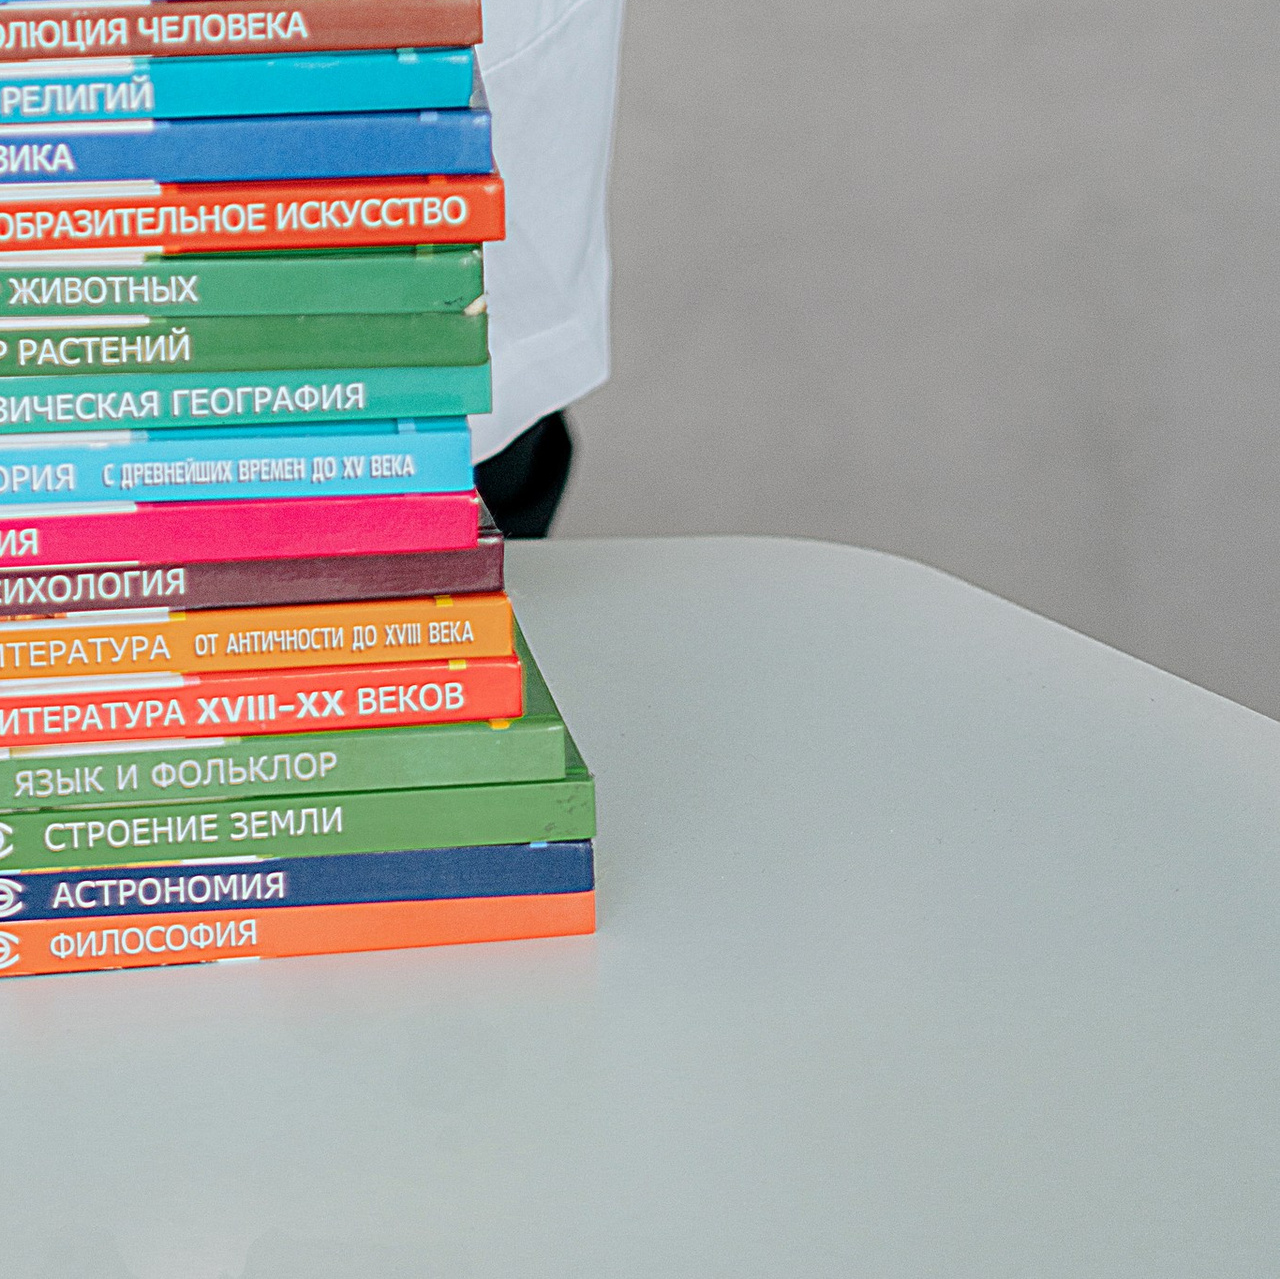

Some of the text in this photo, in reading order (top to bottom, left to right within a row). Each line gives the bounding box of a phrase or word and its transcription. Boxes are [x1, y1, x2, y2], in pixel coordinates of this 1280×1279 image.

[138, 11, 308, 43] ЧЕЛОВЕКА
[1, 74, 155, 115] РЕЛИГИЙ
[276, 195, 468, 232] ИСКУССТВО
[8, 275, 199, 305] ЖИВОТНЫХ
[19, 327, 192, 366] РАСТЕНИЙ
[172, 382, 365, 416] ГЕОГРАФИЯ
[102, 463, 115, 487] С
[120, 455, 232, 490] ДРЕВНЕЙШИХ
[238, 456, 305, 482] ВРЕМЕН
[311, 457, 336, 484] ДО
[370, 453, 415, 477] ВЕКА
[194, 631, 218, 658] ОТ
[227, 625, 344, 657] АНТИЧНОСТИ
[352, 626, 377, 653] ДО
[428, 619, 475, 644] ВЕКА
[357, 682, 464, 716] ВЕКОВ
[14, 766, 105, 799] ЯЗЫК
[117, 764, 138, 791] И
[151, 752, 338, 788] ФОЛЬКЛОР
[44, 814, 219, 852] СТРОЕНИЕ
[229, 806, 343, 841] ЗЕМЛИ
[52, 871, 286, 909] АСТРОНОМИЯ
[49, 919, 258, 959] ФИЛОСОФИЯ
